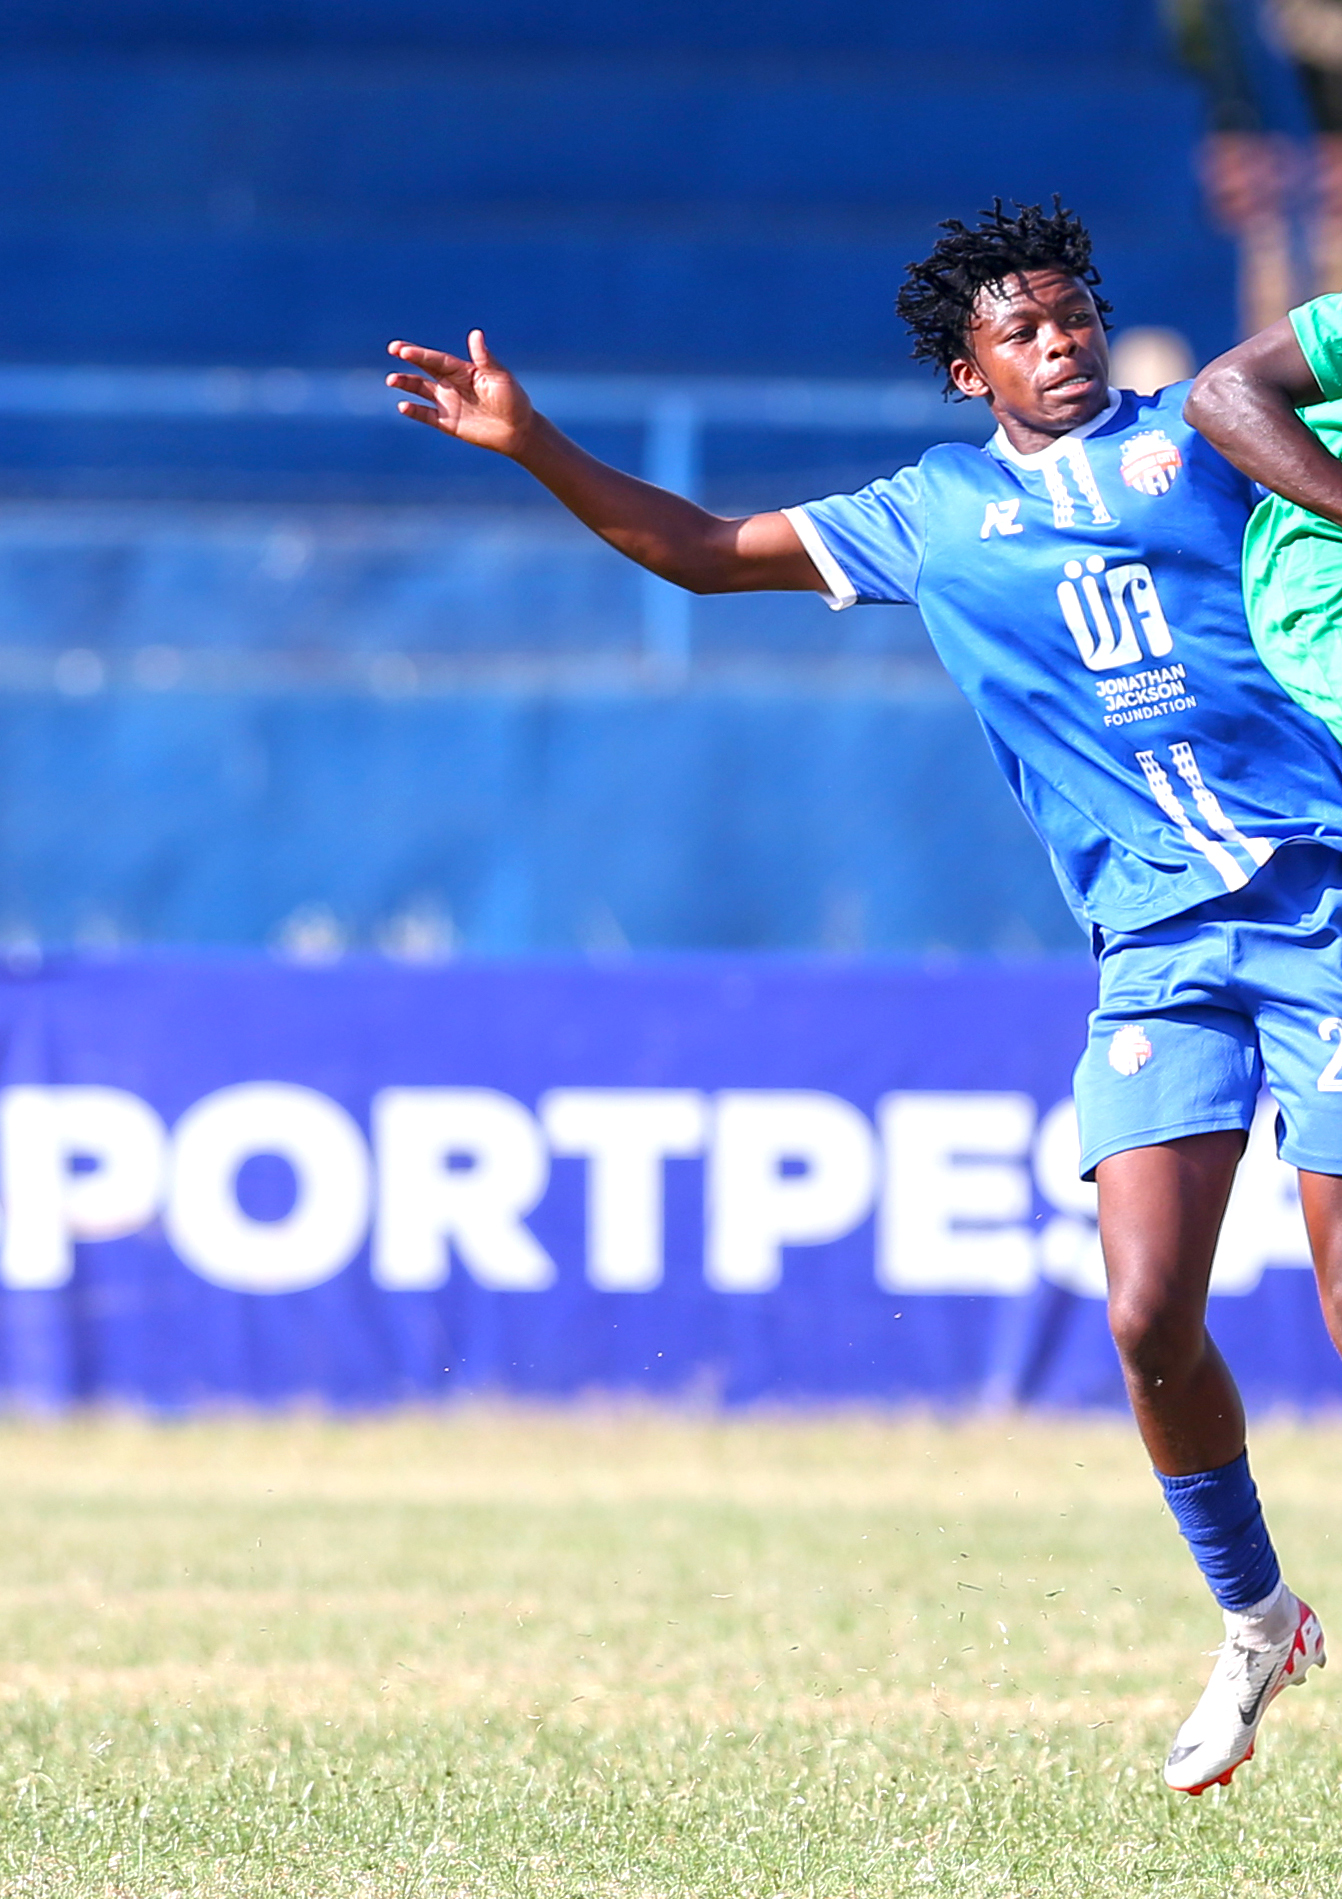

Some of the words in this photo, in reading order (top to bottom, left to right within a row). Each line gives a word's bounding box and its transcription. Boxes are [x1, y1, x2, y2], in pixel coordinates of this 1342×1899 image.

[1095, 663, 1186, 697] JONATHAN
[1105, 680, 1186, 712] JACKSON
[1103, 695, 1198, 727] FOUNDATION
